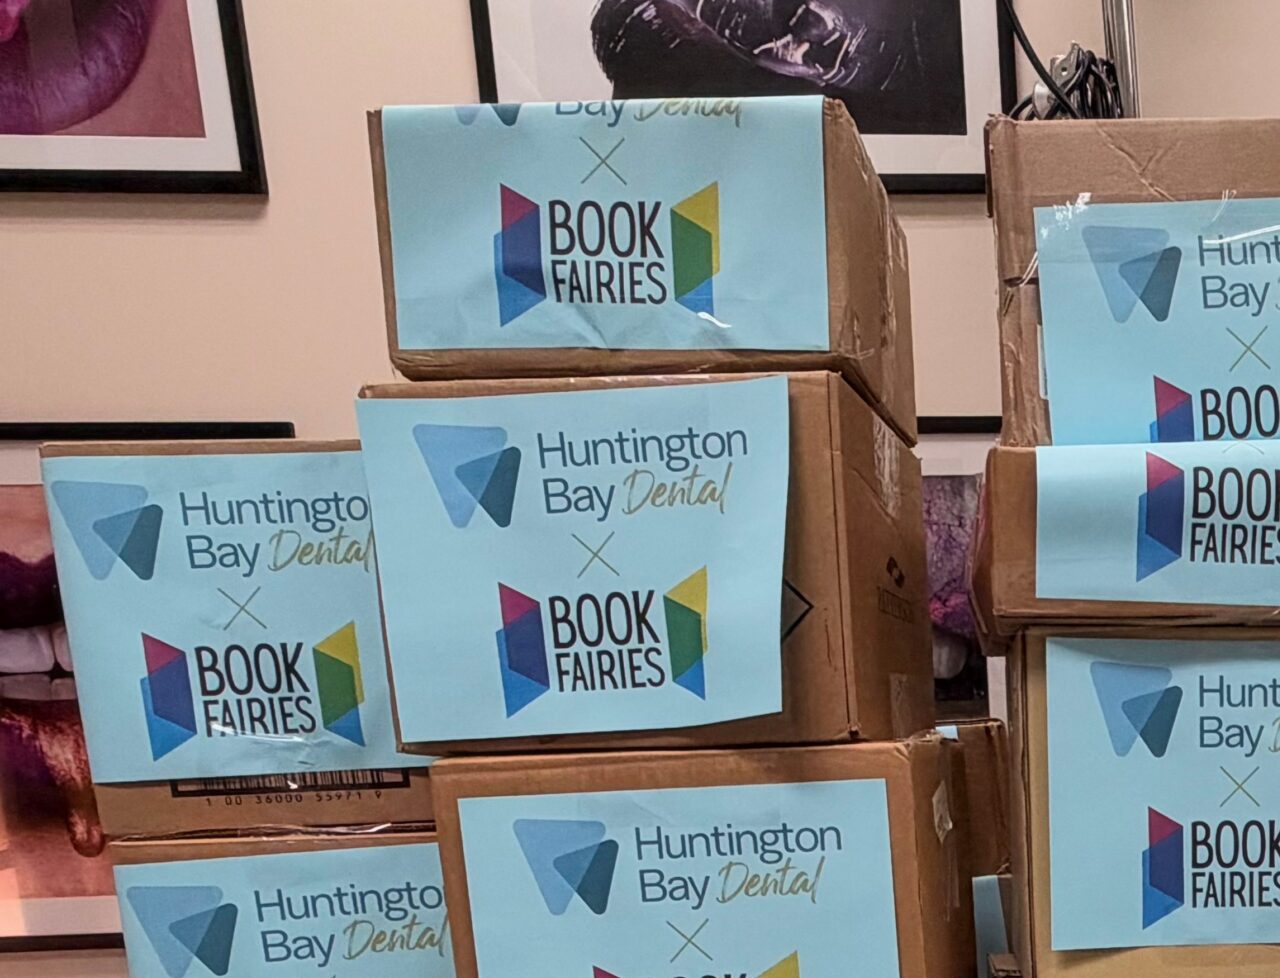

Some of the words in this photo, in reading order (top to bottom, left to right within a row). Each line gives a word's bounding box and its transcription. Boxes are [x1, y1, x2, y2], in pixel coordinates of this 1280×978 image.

[549, 200, 664, 258] BOOK
[551, 260, 666, 304] FAIRIES
[1201, 276, 1270, 317] Bay
[537, 425, 748, 476] Huntington
[180, 491, 369, 528] Huntingto
[543, 478, 615, 522] Bay
[622, 462, 732, 514] Dental
[186, 535, 260, 577] Bay
[267, 530, 372, 572] Dental
[549, 590, 660, 649] BOOK
[195, 643, 310, 696] BOOK
[555, 647, 665, 692] FAIRIES
[203, 696, 316, 737] FAIRIES
[1200, 716, 1264, 757] Bay
[635, 823, 841, 864] Huntington
[254, 881, 443, 922] Huntingto
[639, 869, 710, 910] Bay
[716, 856, 825, 903] Dental
[261, 930, 335, 967] Bay
[343, 914, 450, 961] Dental
